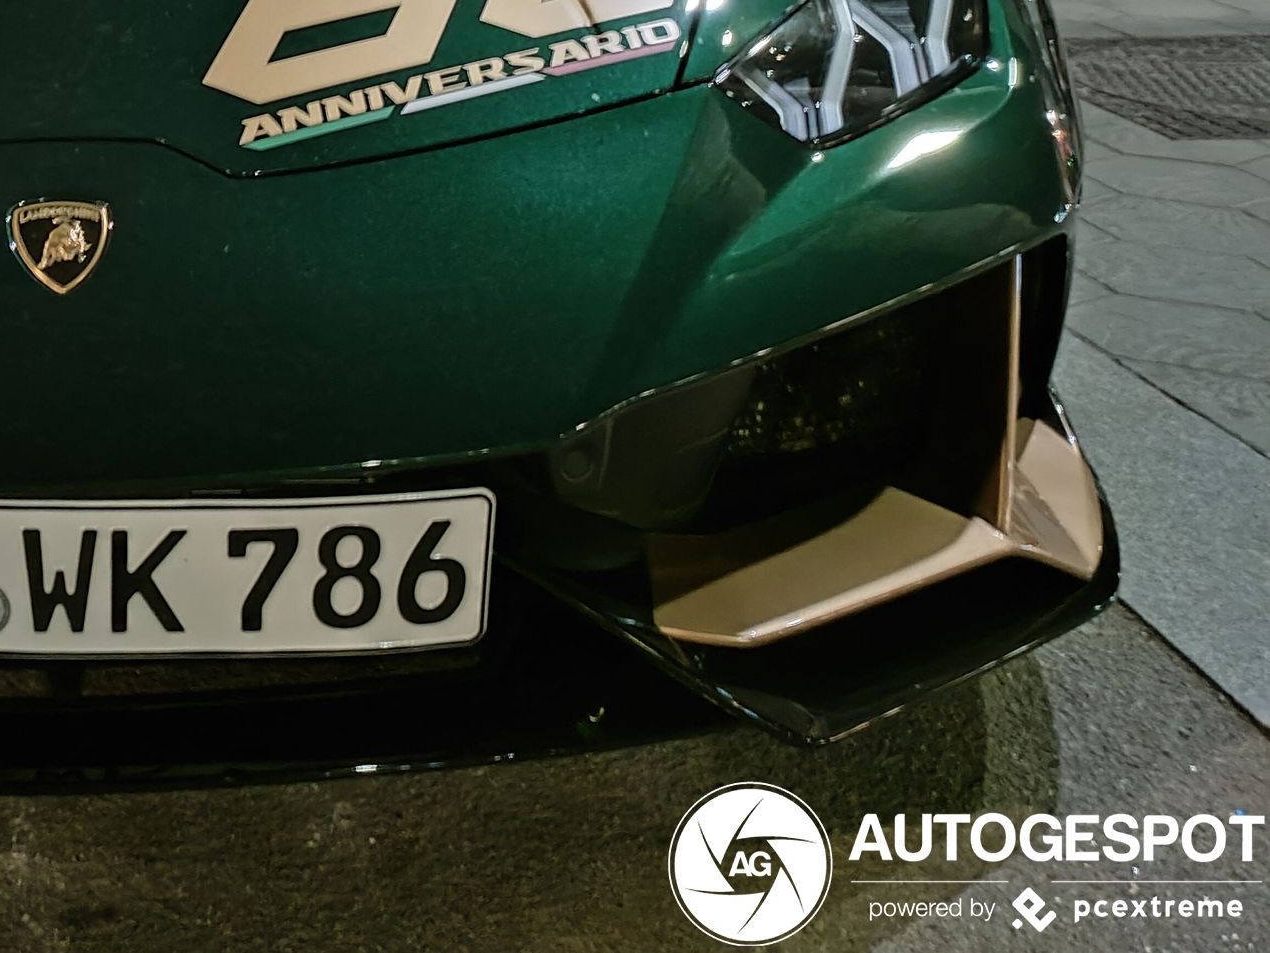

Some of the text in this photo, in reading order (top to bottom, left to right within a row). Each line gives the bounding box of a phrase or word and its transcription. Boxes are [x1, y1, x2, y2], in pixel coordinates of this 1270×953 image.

[239, 16, 682, 146] ANNIVERSARIO
[21, 528, 188, 634] WK
[227, 519, 468, 633] 786
